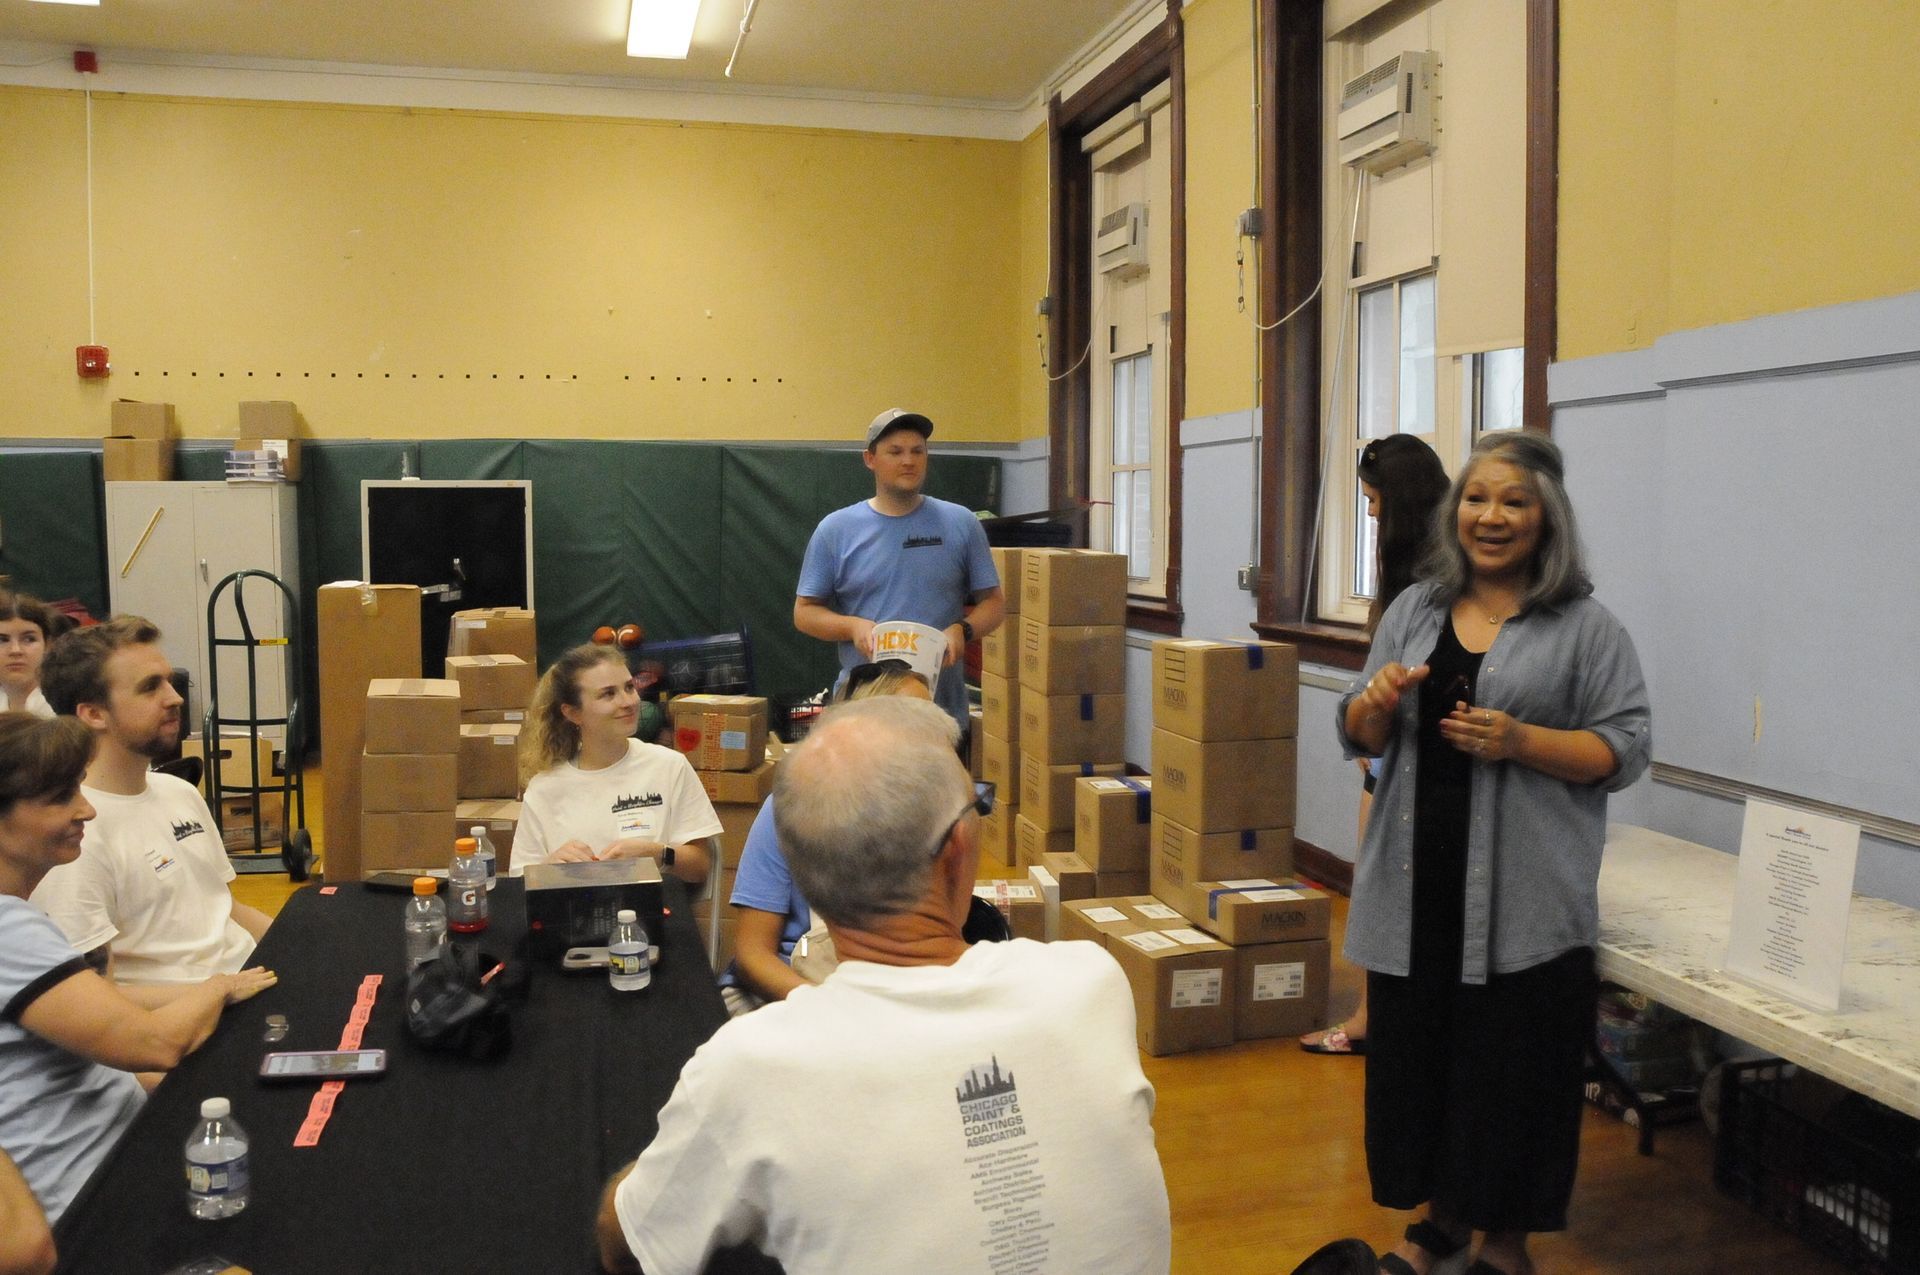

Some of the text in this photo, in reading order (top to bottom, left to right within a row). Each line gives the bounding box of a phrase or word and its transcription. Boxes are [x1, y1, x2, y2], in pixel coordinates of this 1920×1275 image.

[878, 631, 919, 652] HDX
[1163, 686, 1188, 704] MACKIN
[462, 889, 476, 906] G
[1261, 911, 1306, 926] MACKIN
[960, 1093, 1017, 1115] CHICAGO
[962, 1104, 1020, 1125] PAINT &
[964, 1115, 1023, 1137] COATINGS
[967, 1126, 1026, 1148] ASSOCIATION
